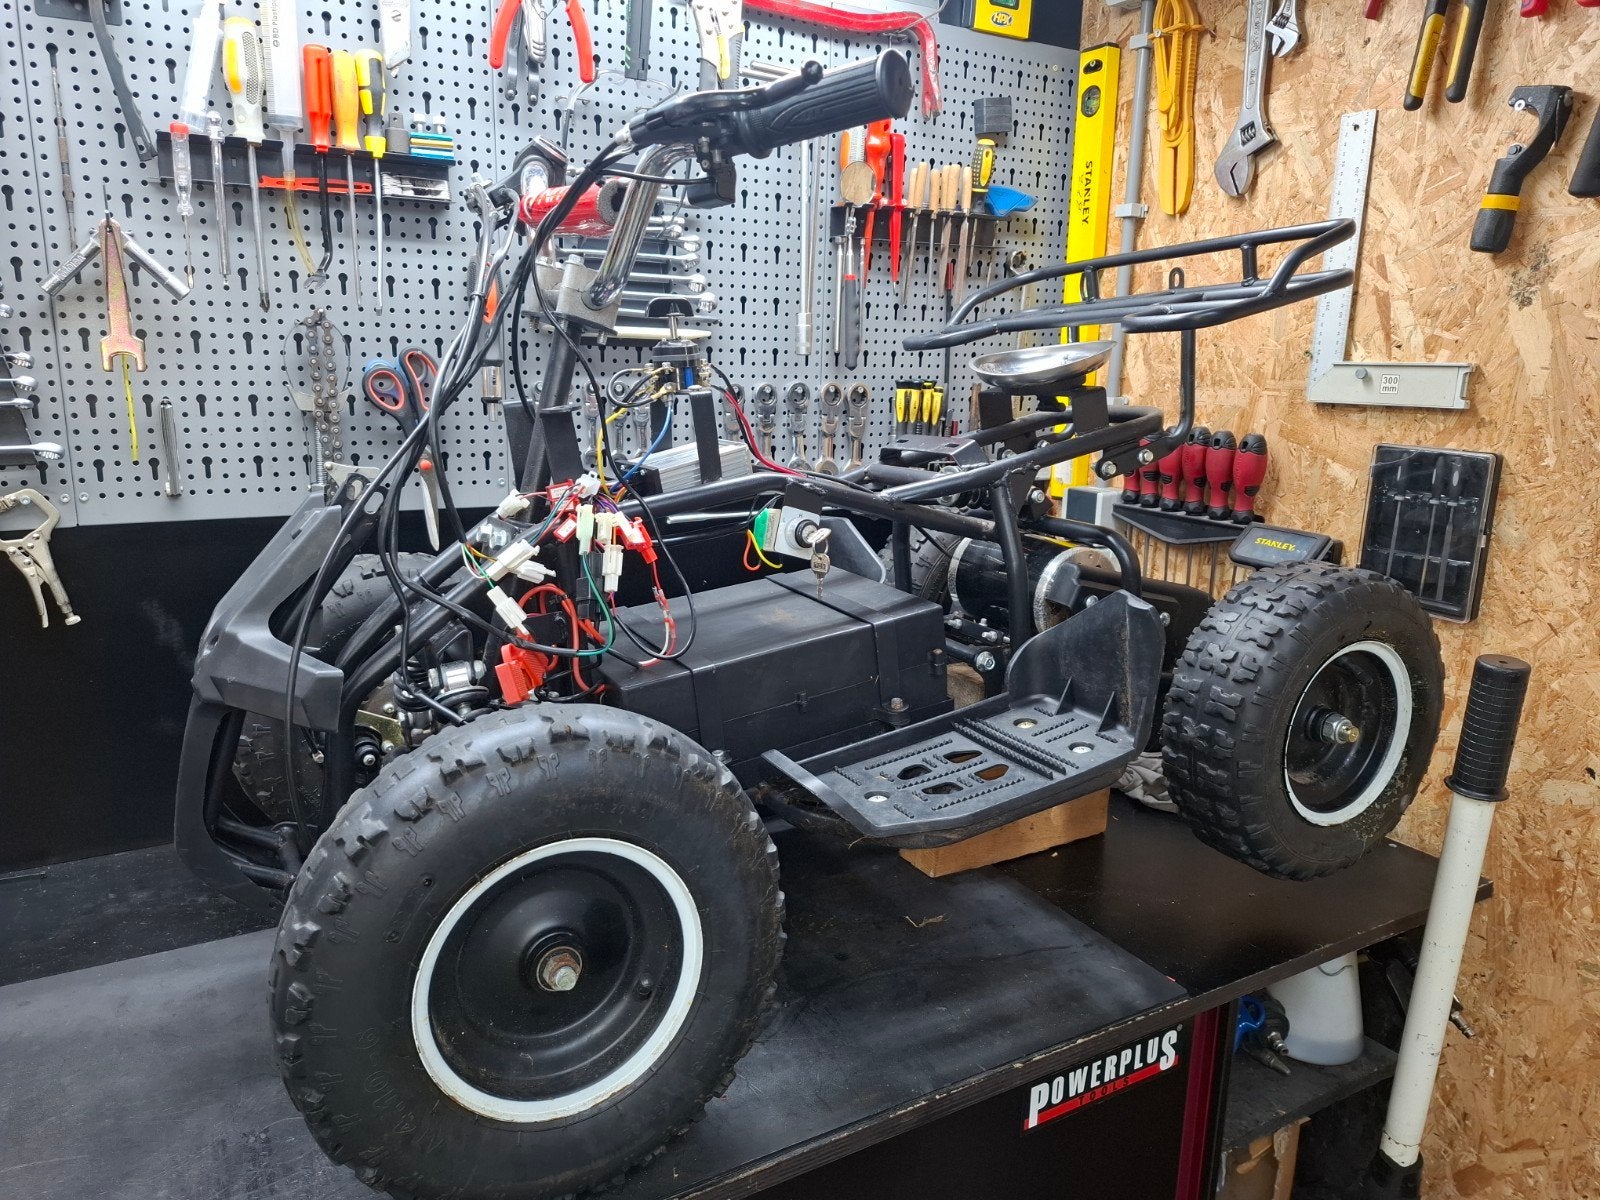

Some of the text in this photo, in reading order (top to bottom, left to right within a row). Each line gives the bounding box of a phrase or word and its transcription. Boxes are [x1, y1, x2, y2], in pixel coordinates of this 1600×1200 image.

[1081, 160, 1093, 225] STANLEY
[1383, 376, 1398, 385] 300
[1254, 537, 1296, 552] STANLEY
[1028, 1029, 1178, 1129] POWERPLUS
[1078, 1076, 1131, 1106] TOOLS
